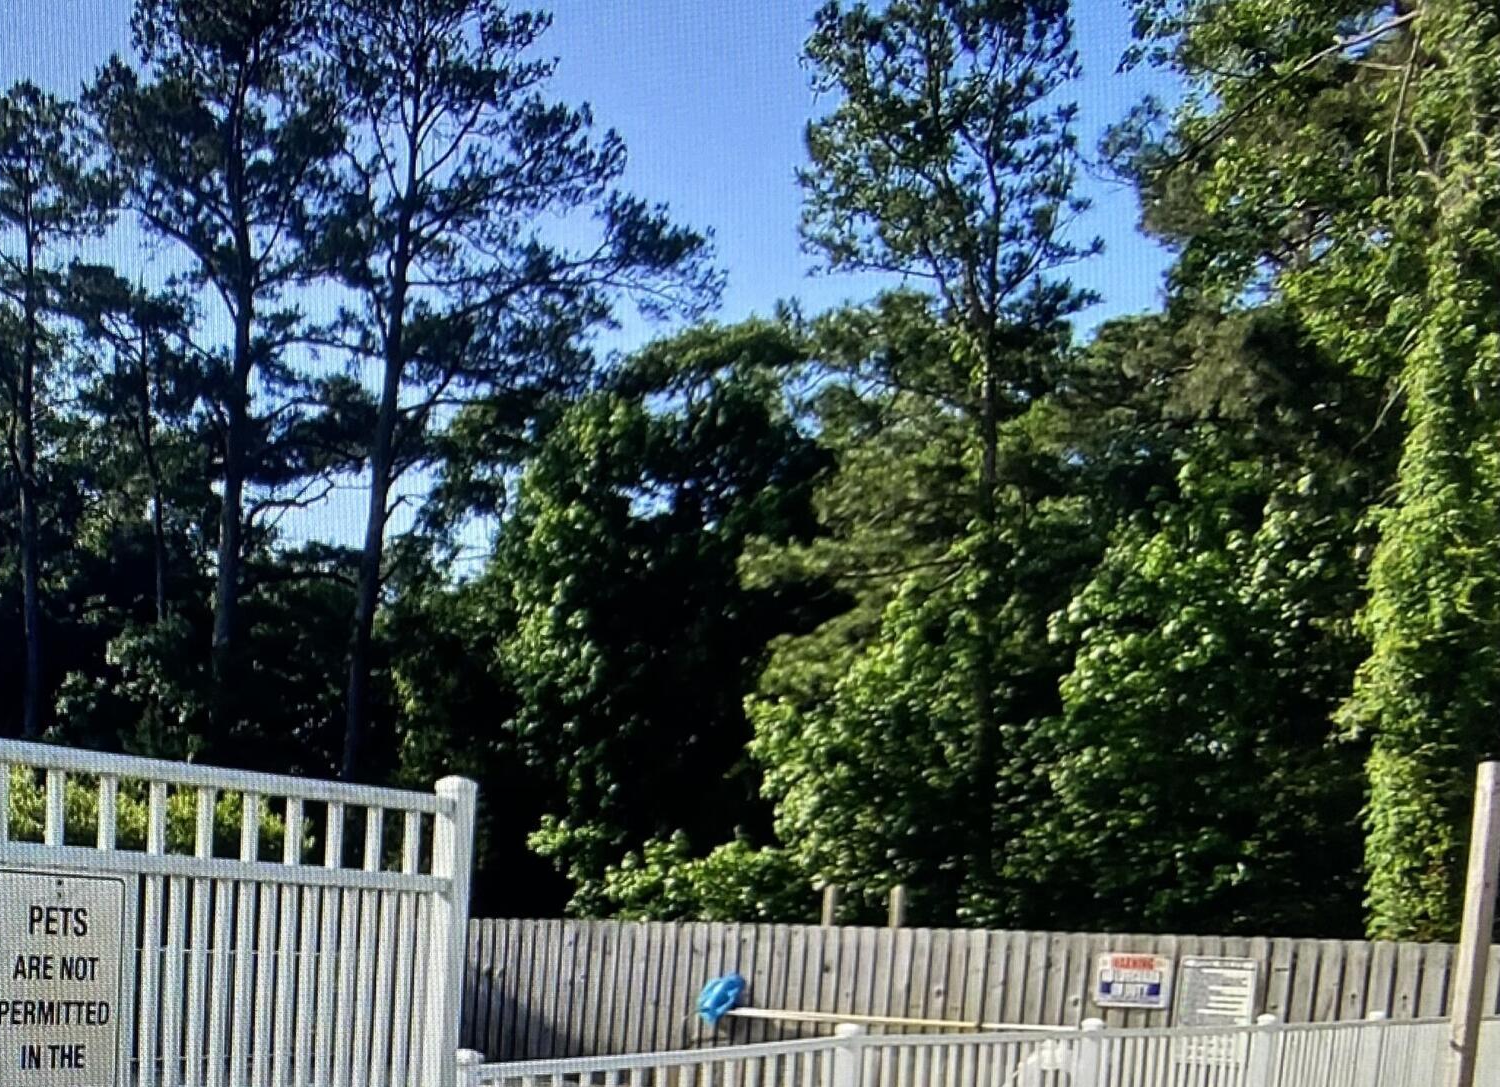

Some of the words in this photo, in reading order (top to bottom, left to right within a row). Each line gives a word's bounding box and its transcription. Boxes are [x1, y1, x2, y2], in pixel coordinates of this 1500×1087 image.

[28, 905, 88, 936] PETS
[12, 955, 55, 981] ARE
[60, 957, 99, 981] NOT
[20, 1045, 42, 1070] IN
[46, 1044, 85, 1069] THE
